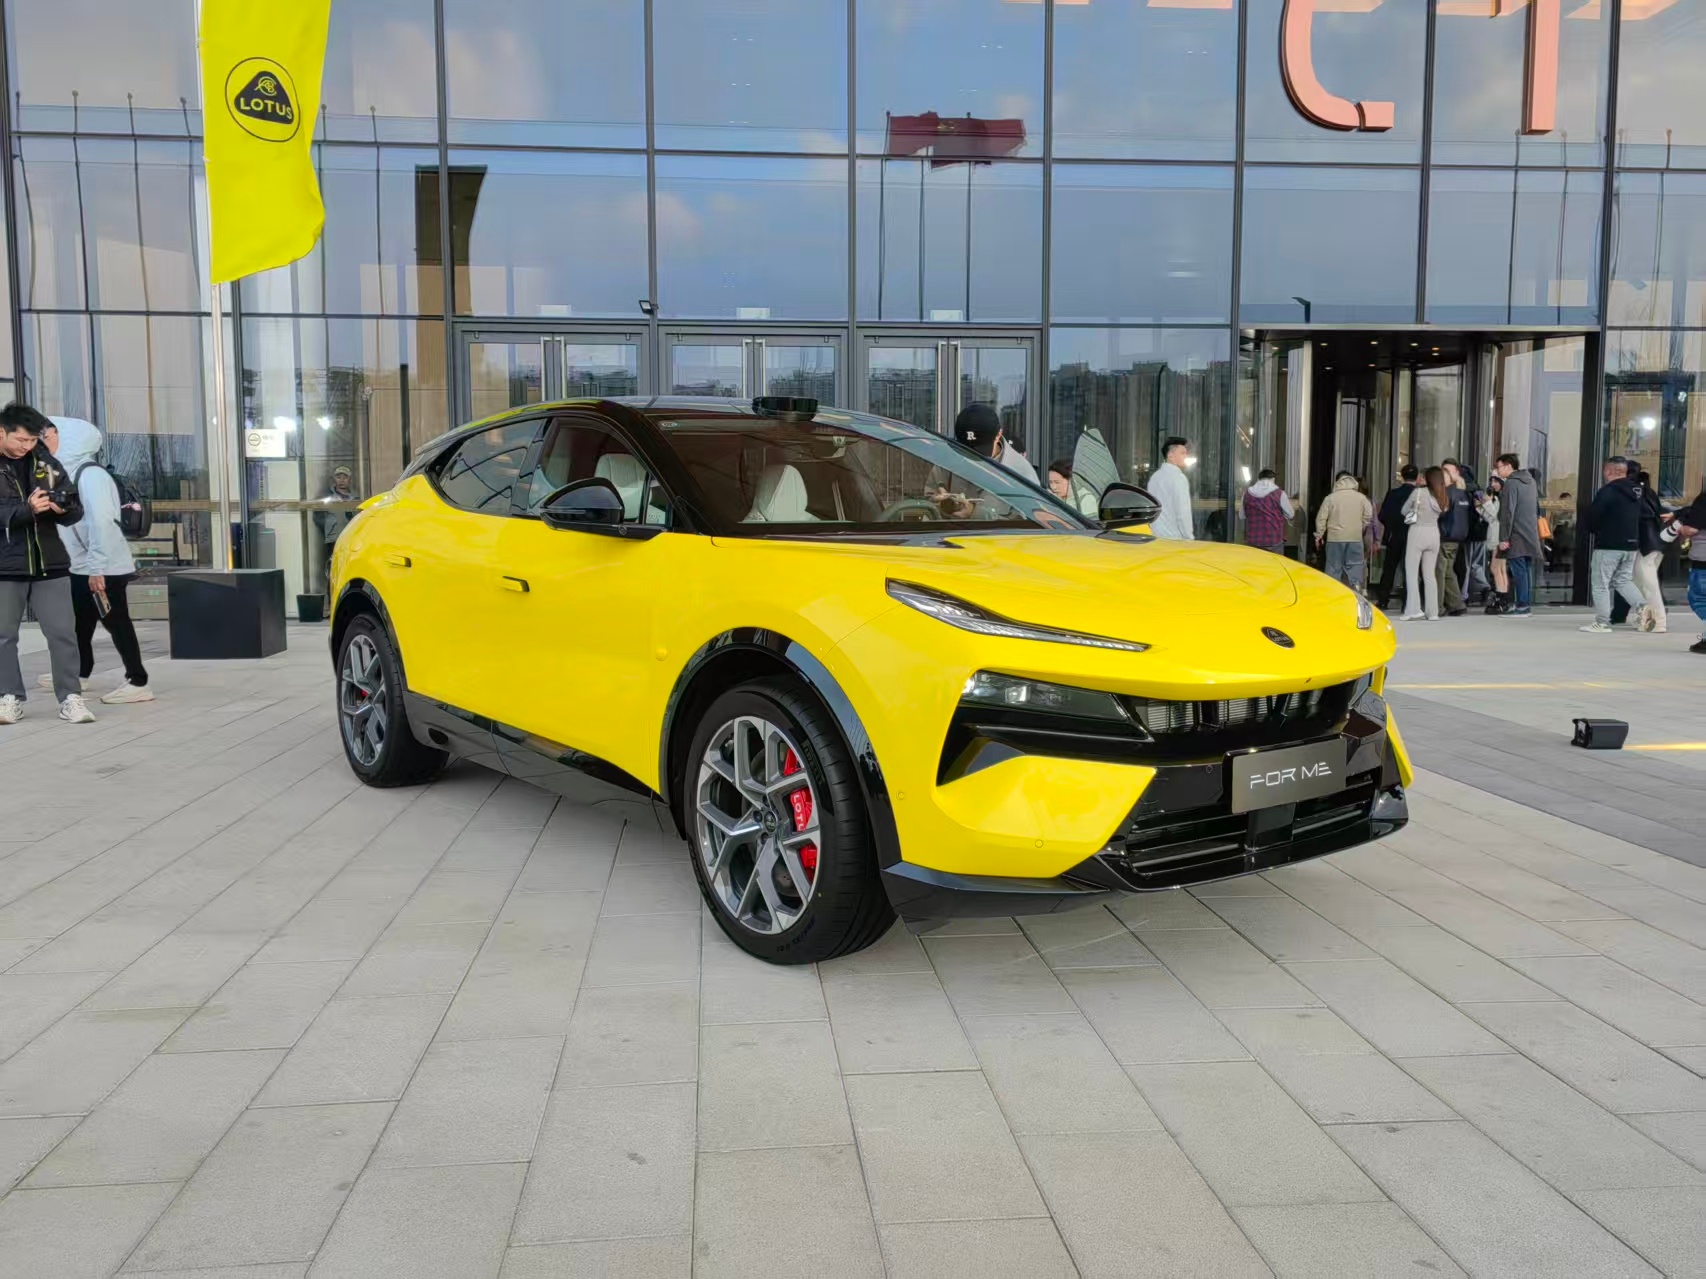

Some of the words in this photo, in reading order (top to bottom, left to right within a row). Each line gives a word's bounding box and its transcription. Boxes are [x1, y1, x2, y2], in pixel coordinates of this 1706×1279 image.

[240, 97, 292, 120] LOTUS
[966, 431, 977, 441] R
[1250, 767, 1297, 790] FOR
[1301, 761, 1333, 780] ME
